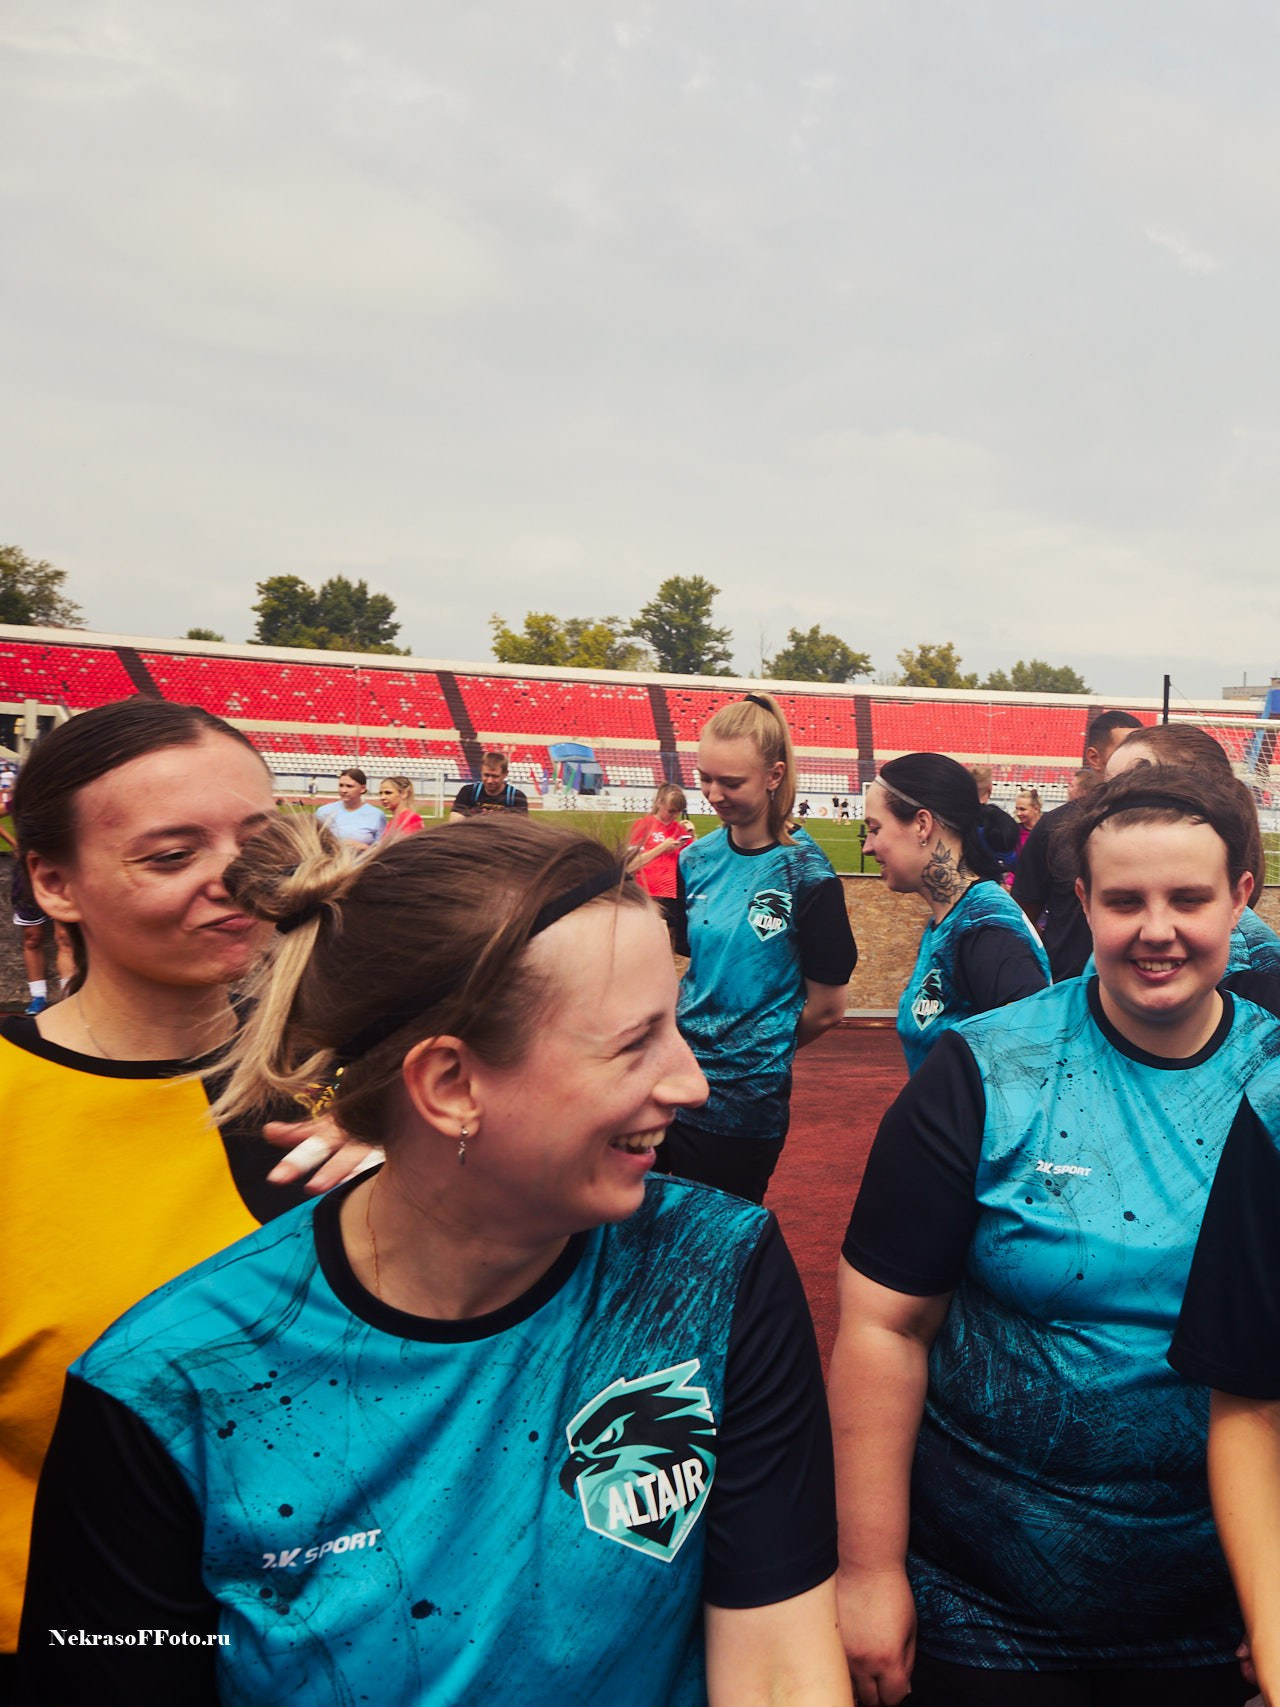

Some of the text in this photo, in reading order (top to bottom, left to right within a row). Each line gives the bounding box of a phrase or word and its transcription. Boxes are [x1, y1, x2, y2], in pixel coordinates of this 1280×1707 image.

[652, 831, 666, 843] 35
[753, 913, 782, 931] ALTAIR
[1053, 1165, 1092, 1177] SPORT
[608, 1457, 706, 1530] ALTAIR
[304, 1528, 382, 1564] SPORT
